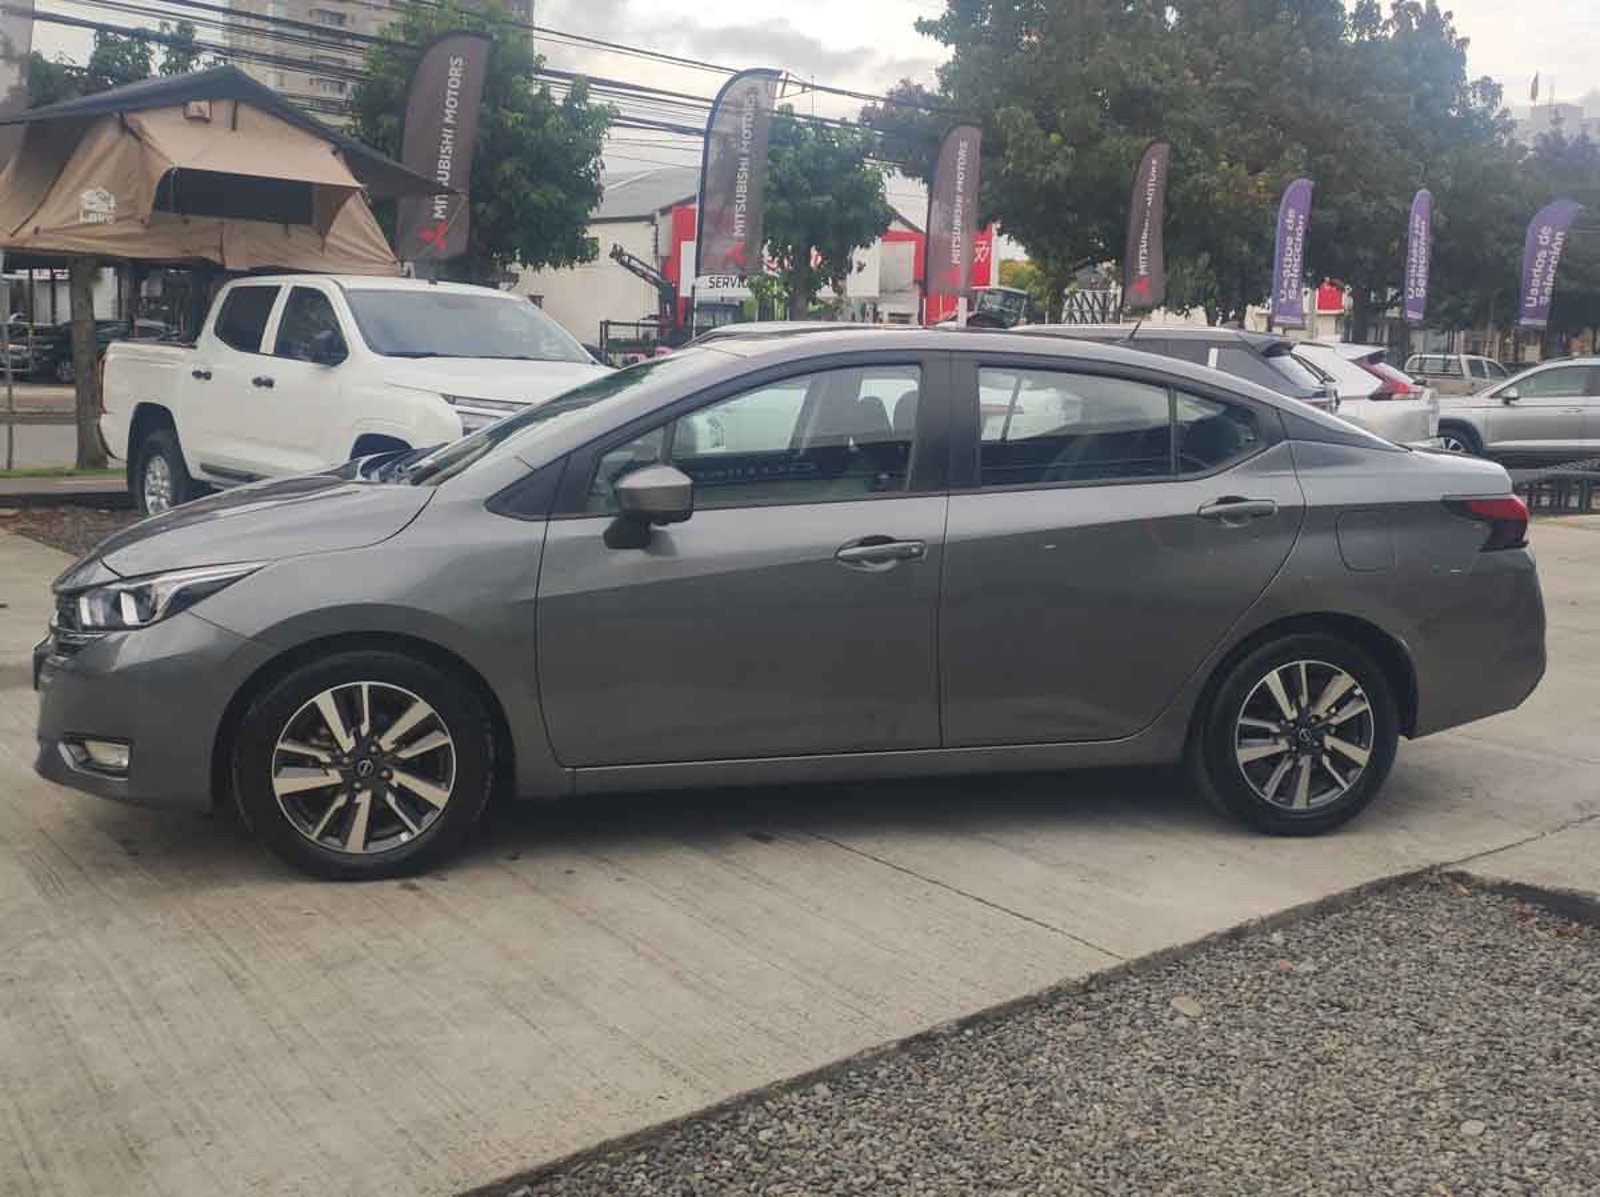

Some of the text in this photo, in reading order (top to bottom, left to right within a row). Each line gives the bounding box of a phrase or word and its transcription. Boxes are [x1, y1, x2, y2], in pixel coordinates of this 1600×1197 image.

[432, 55, 465, 220] MITUBISHI MOTORS
[733, 157, 751, 237] MITSUBISHI
[951, 138, 969, 265] MITSUBISHI MOTORS
[1538, 225, 1553, 246] de
